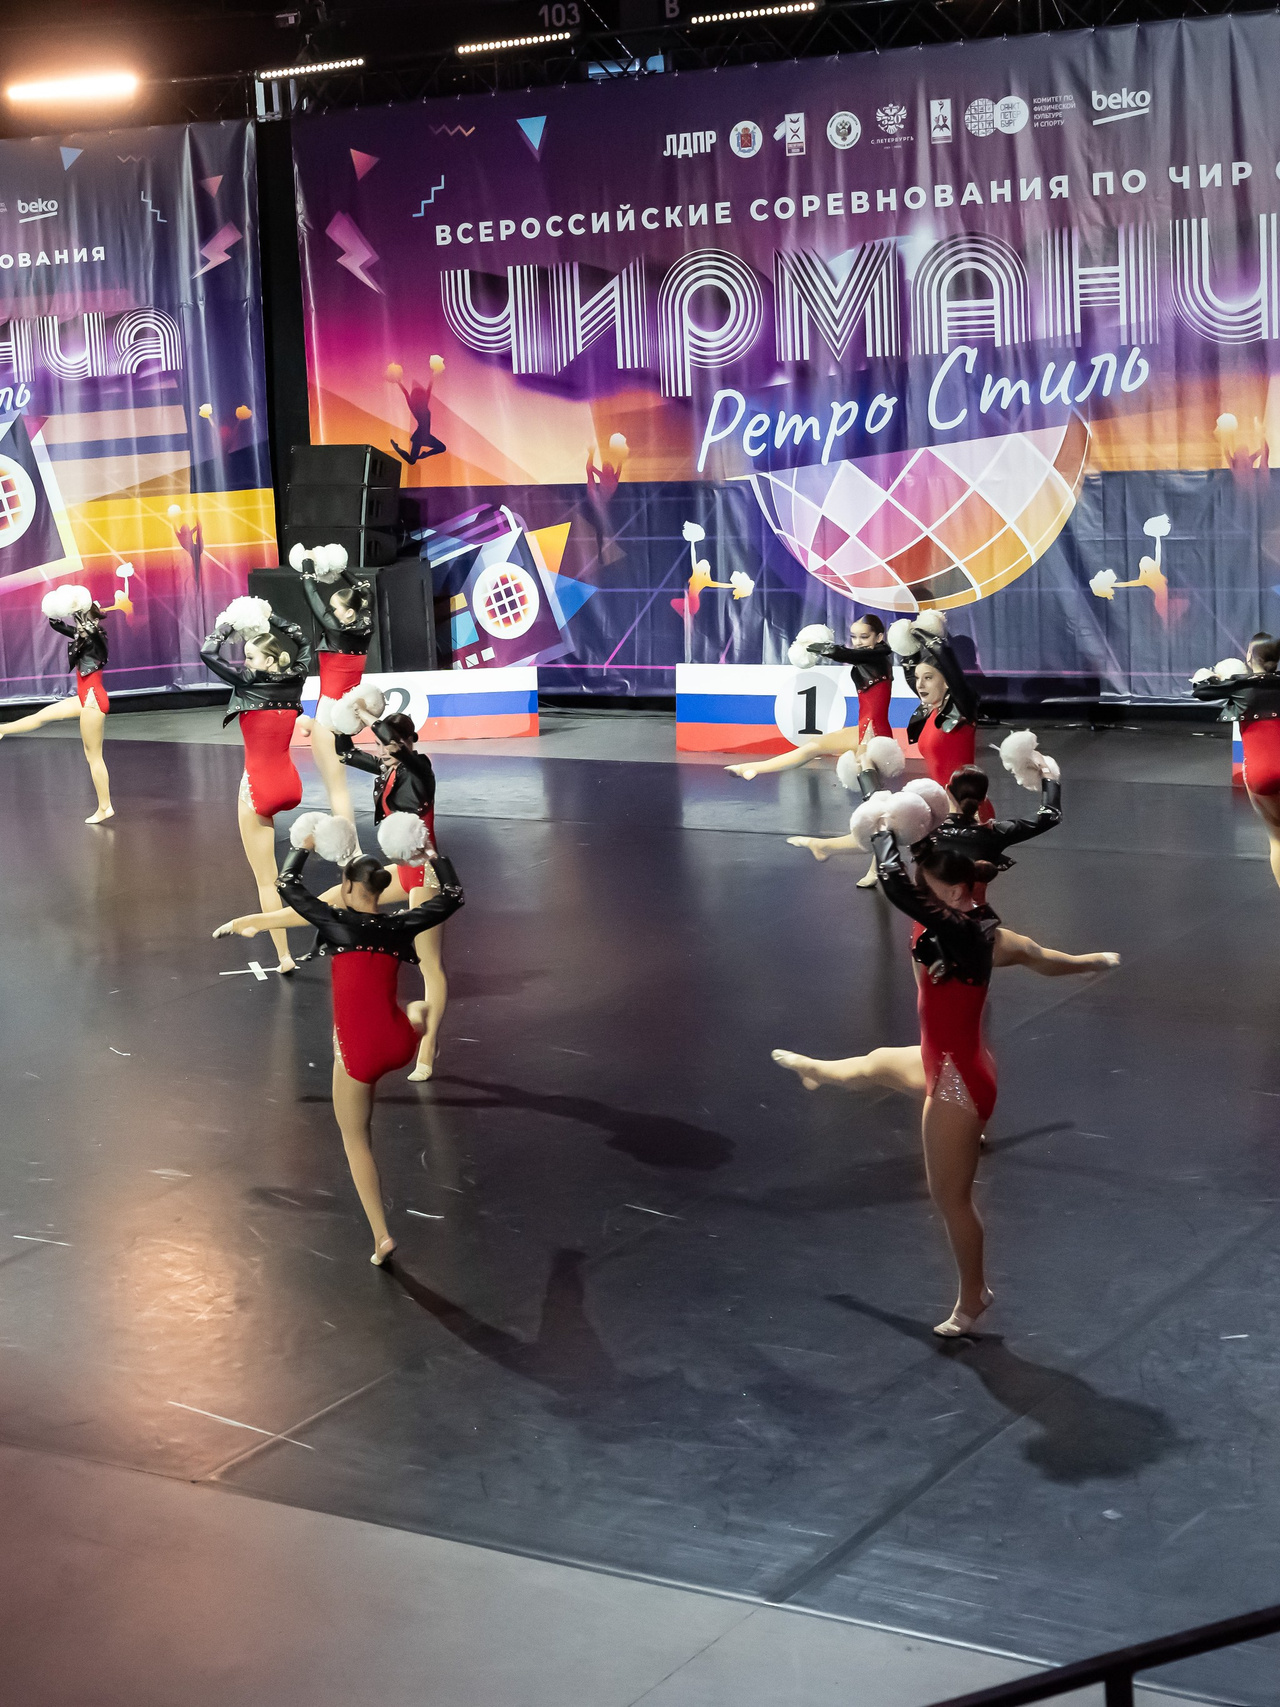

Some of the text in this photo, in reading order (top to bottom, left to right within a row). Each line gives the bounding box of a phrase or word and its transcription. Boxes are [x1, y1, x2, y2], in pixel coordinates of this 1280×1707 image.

[538, 3, 581, 27] 103
[1033, 96, 1062, 104] КОМИТЕТ
[1033, 102, 1076, 112] ФИЗИЧЕСКОЙ
[1091, 88, 1151, 111] beko
[1033, 112, 1063, 120] КУЛЬТУРЕ
[1040, 119, 1065, 128] СПОРТУ
[663, 130, 717, 159] ЛДПР
[17, 198, 59, 214] beko
[435, 201, 733, 246] ВСЕРОССИЙСКИЕ
[749, 174, 1069, 223] СОРЕВНОВАНИЯ
[1092, 169, 1147, 196] ПО
[1169, 161, 1253, 190] ЧИР
[696, 345, 1150, 473] Ретро Стиль
[797, 685, 823, 735] 1
